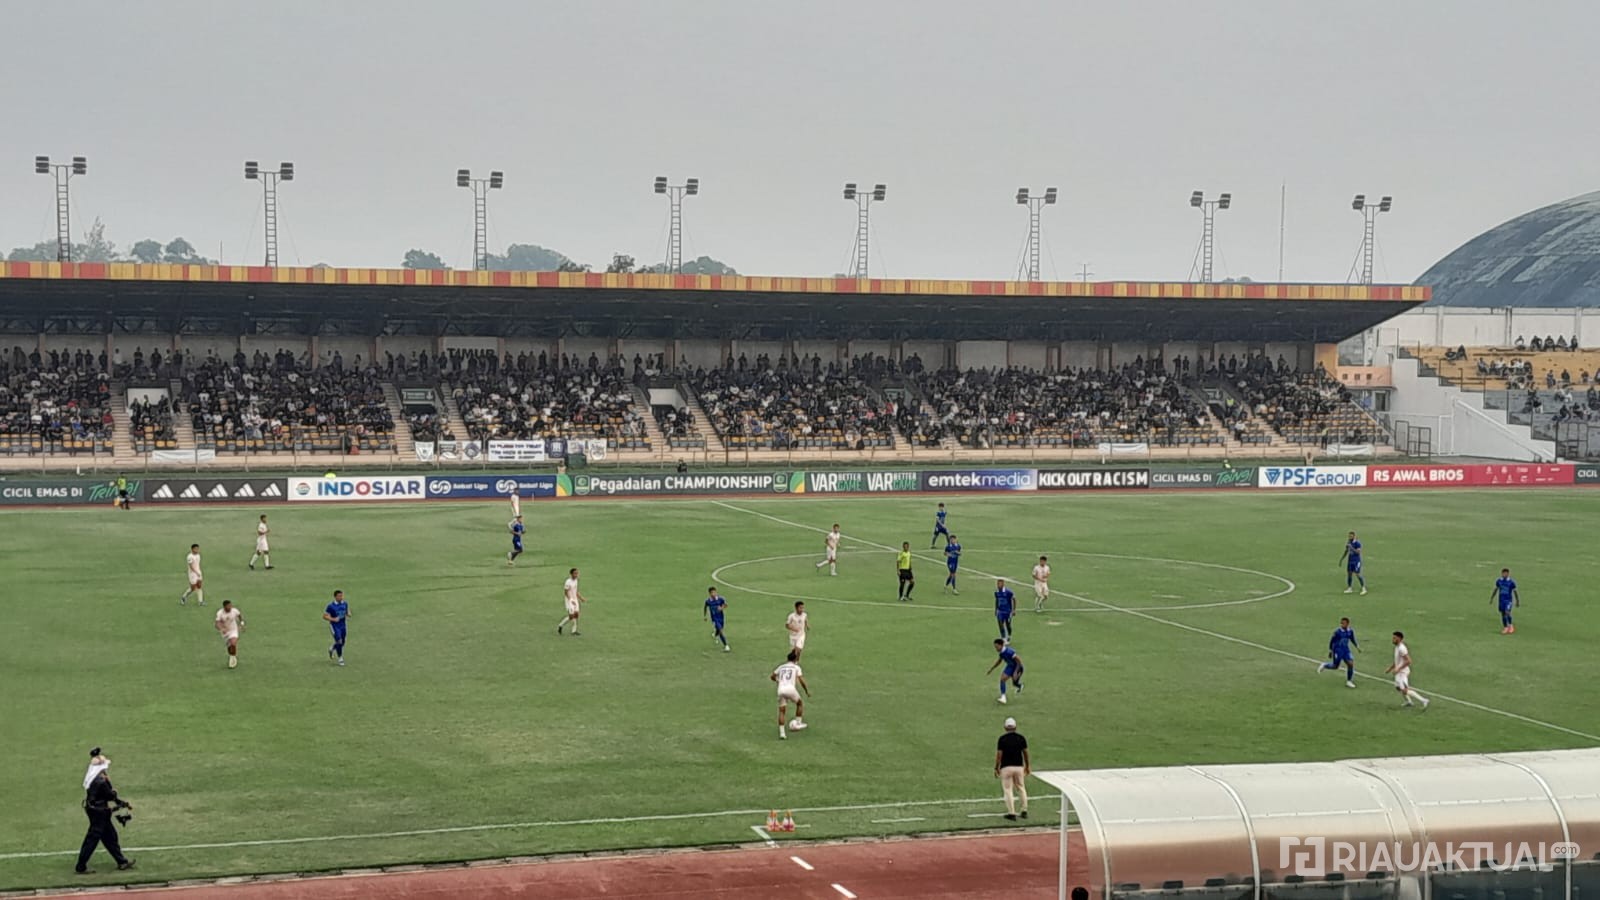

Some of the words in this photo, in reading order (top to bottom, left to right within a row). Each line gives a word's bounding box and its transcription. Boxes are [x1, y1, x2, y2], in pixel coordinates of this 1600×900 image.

[810, 473, 837, 492] VAR
[866, 472, 893, 491] VAR
[928, 471, 1031, 487] emtekmedia
[1038, 472, 1066, 486] KICK
[1067, 472, 1092, 486] OUT
[1093, 471, 1148, 486] RACISM
[1177, 473, 1201, 482] EMAS
[1203, 473, 1212, 482] DI
[1373, 470, 1389, 482] RS
[1392, 470, 1426, 481] AWAL
[1429, 469, 1464, 481] BROS
[317, 480, 421, 496] INDOSIAR
[590, 476, 661, 493] Pegadaian
[664, 475, 772, 489] CHAMPIONSHIP
[3, 487, 33, 498] CICIL
[36, 487, 68, 497] EMAS
[71, 487, 83, 497] DI
